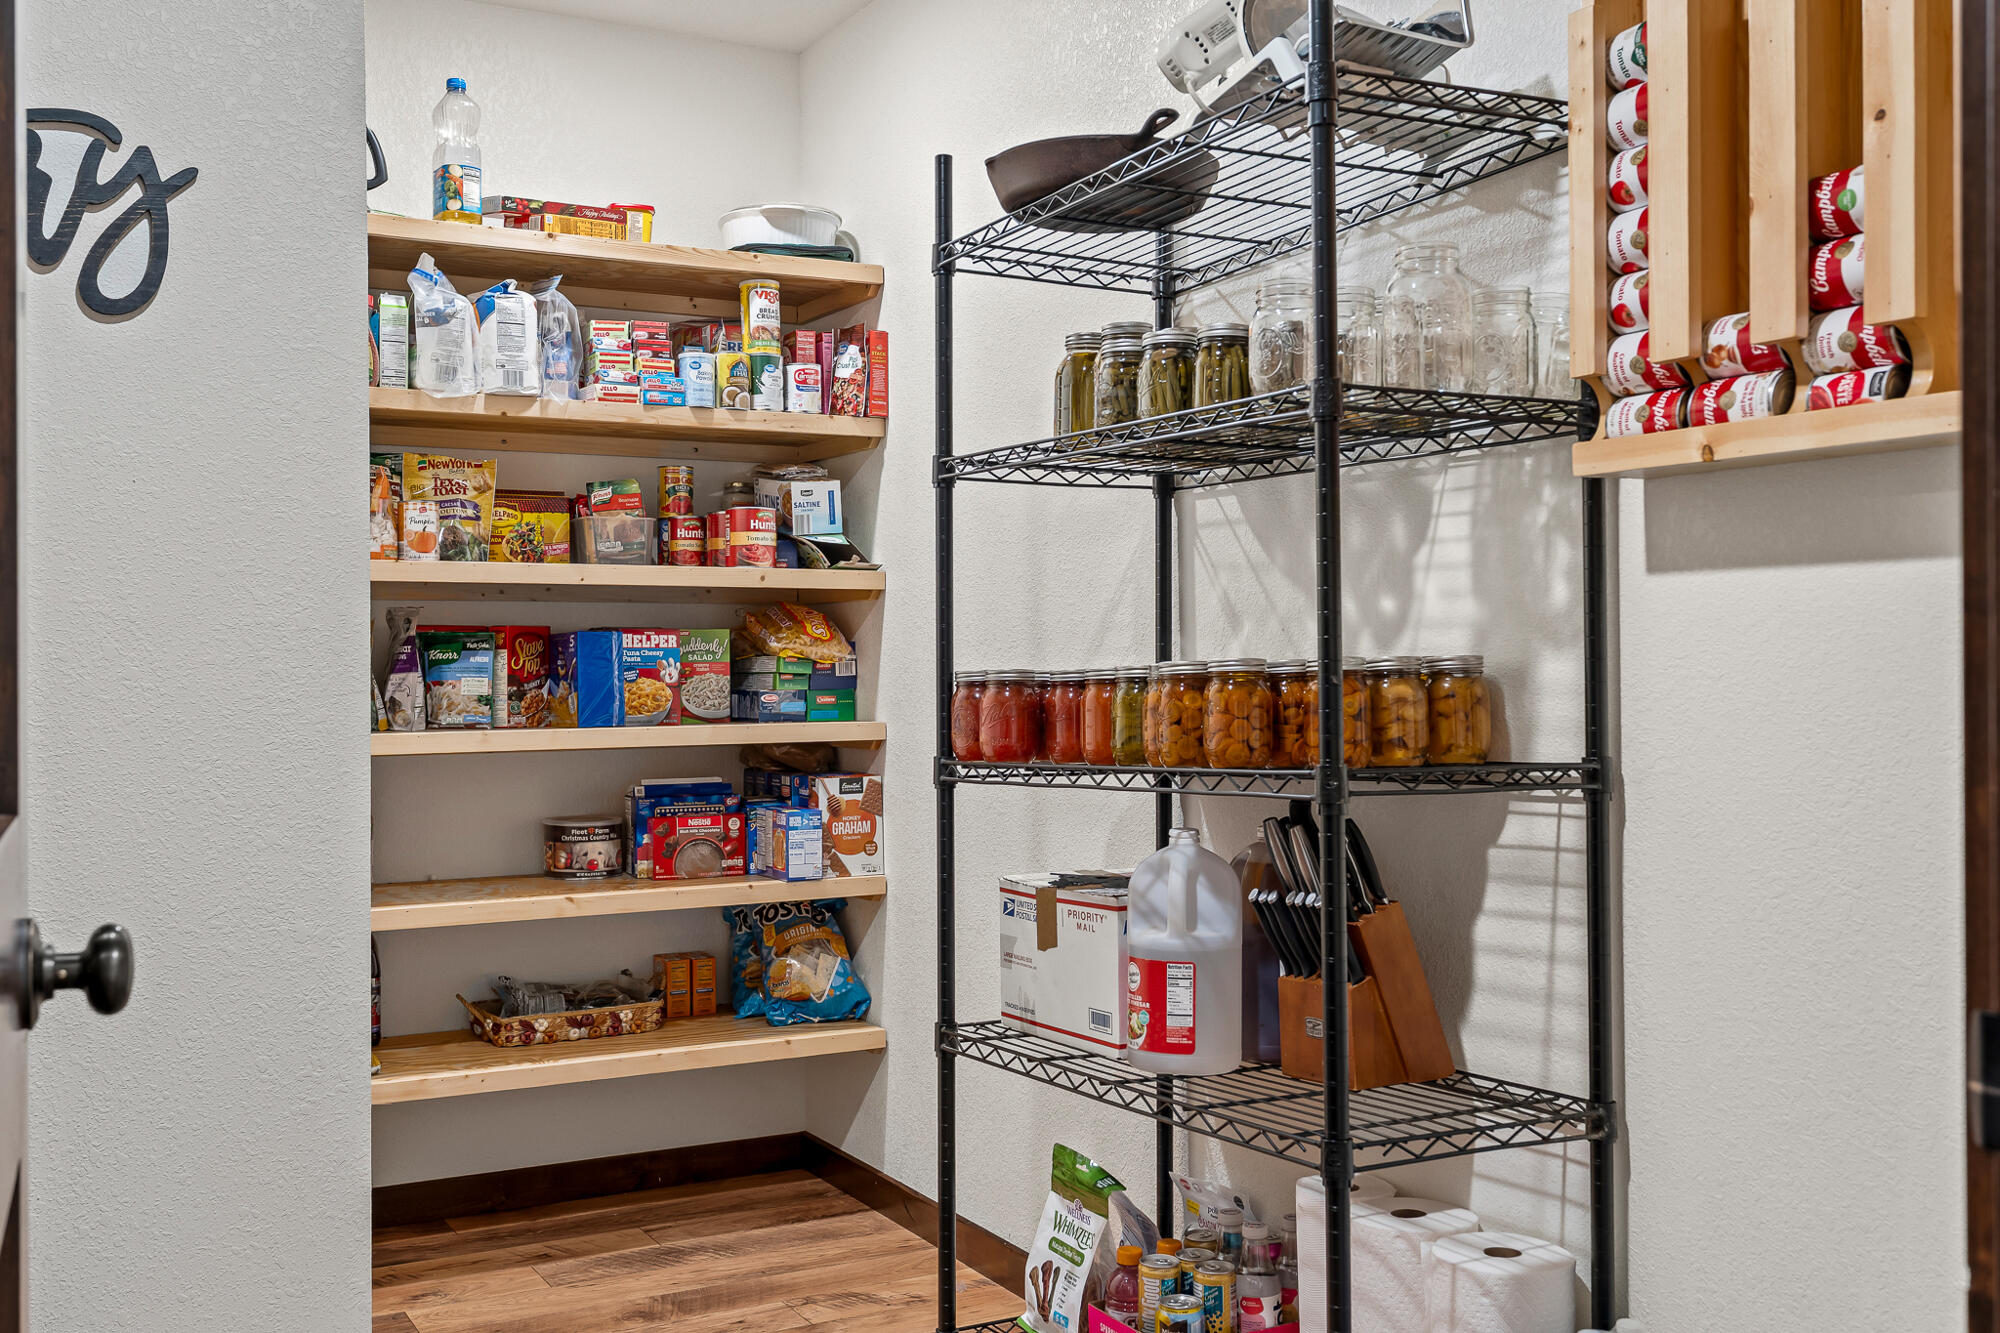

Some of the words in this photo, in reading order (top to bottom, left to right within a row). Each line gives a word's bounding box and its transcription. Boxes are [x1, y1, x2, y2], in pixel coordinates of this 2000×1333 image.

[1616, 46, 1631, 79] Tomato
[1614, 229, 1628, 262] Tomato
[432, 487, 469, 497] TOAST
[793, 501, 821, 509] SALTINE
[622, 633, 678, 648] HELPER
[428, 649, 460, 661] Knorr
[511, 638, 545, 670] Stove
[523, 657, 540, 678] Top
[832, 820, 871, 835] GRAHAM
[1016, 900, 1033, 911] UNITED
[1015, 910, 1032, 922] POSTAL
[1067, 909, 1105, 924] PRIORITY
[1076, 922, 1096, 933] MAIL
[1066, 1205, 1092, 1226] WELLNESS
